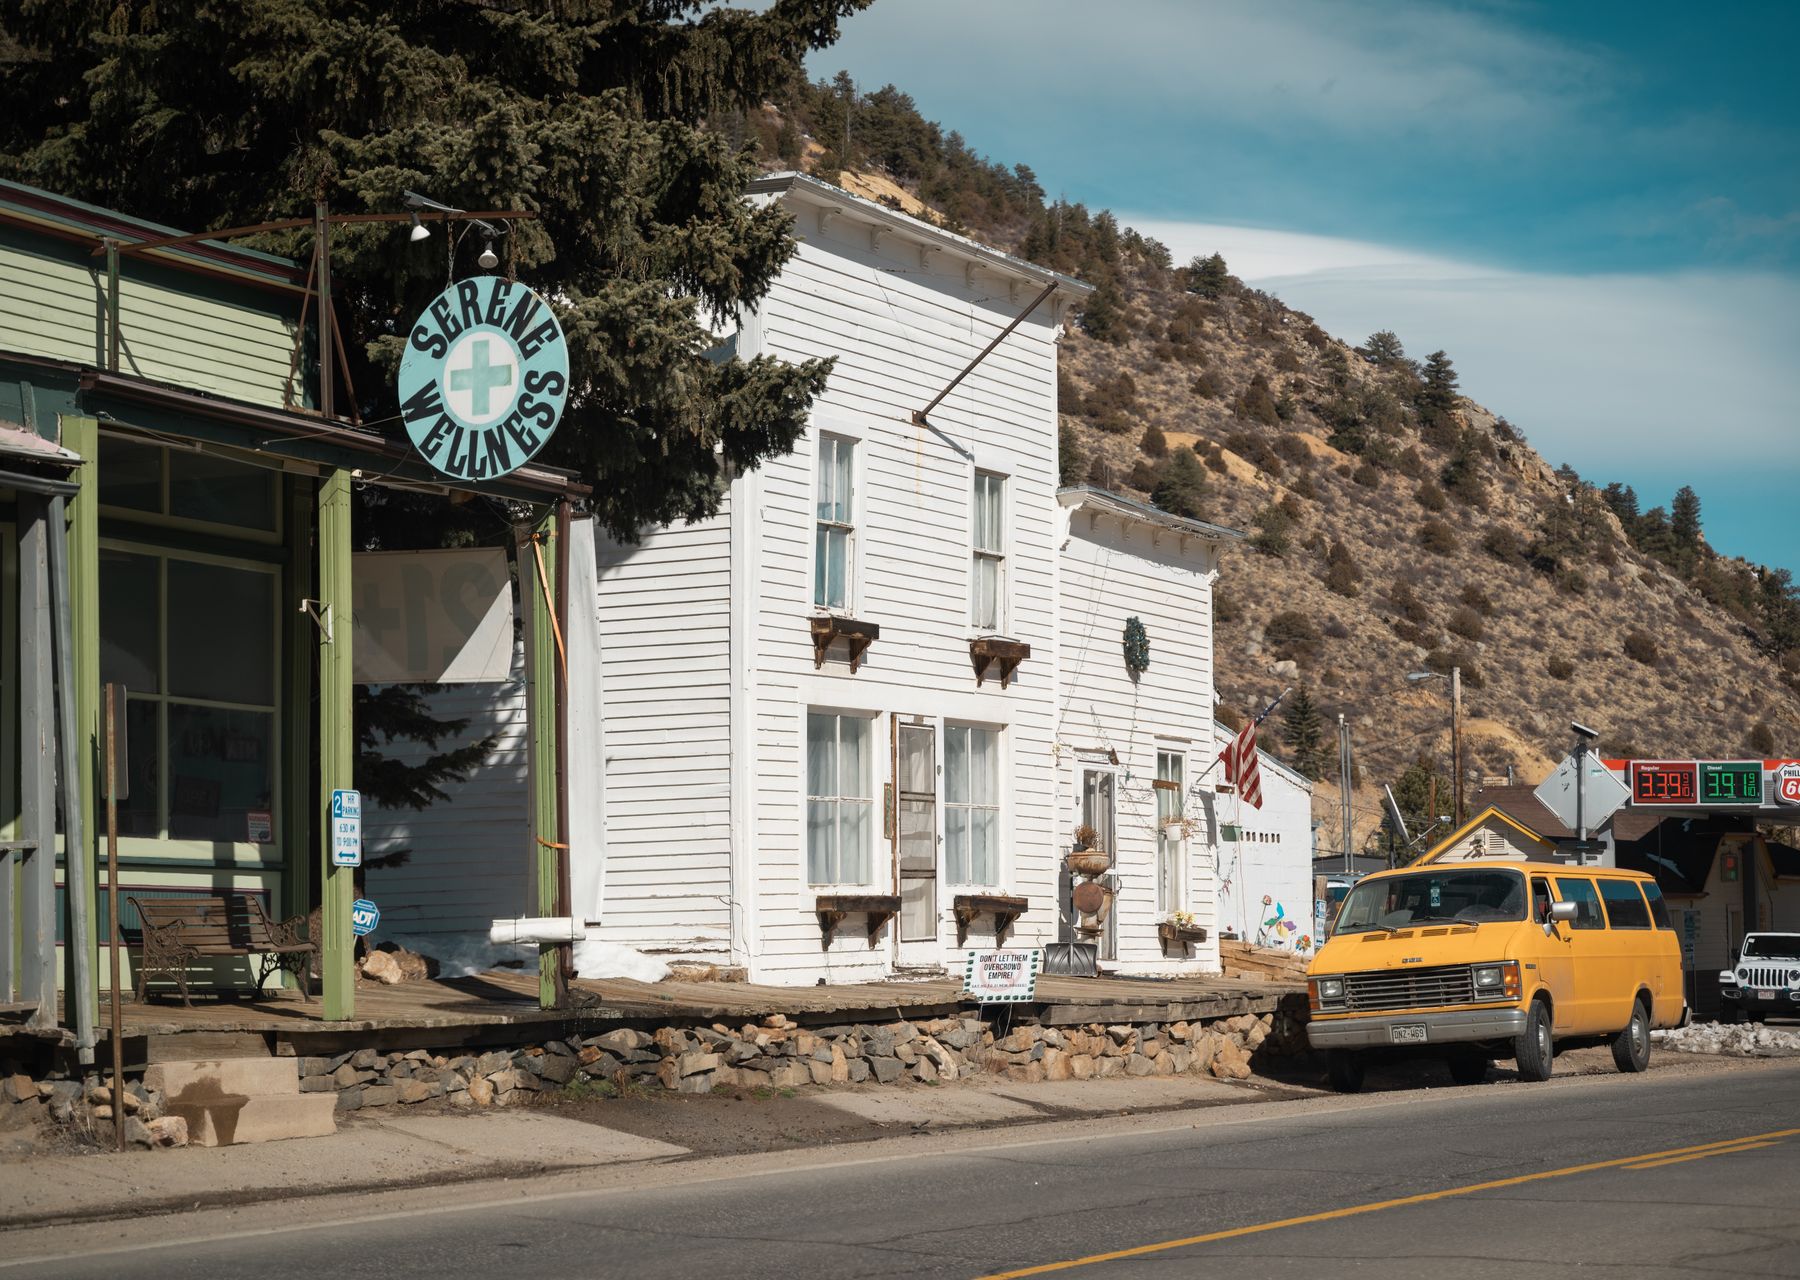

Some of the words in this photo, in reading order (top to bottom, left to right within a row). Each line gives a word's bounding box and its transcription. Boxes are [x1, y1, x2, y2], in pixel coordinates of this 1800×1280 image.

[411, 278, 560, 361] SERENE
[401, 370, 566, 478] WELLNESS
[1642, 773, 1681, 797] 3.39
[1708, 773, 1747, 797] 3.91
[1786, 781, 1800, 795] 6
[335, 795, 341, 814] 2
[342, 806, 359, 817] PARKING
[353, 910, 375, 926] ADT
[998, 954, 1010, 962] LET
[1011, 954, 1028, 962] THEM
[984, 963, 1021, 971] OVERCROWD
